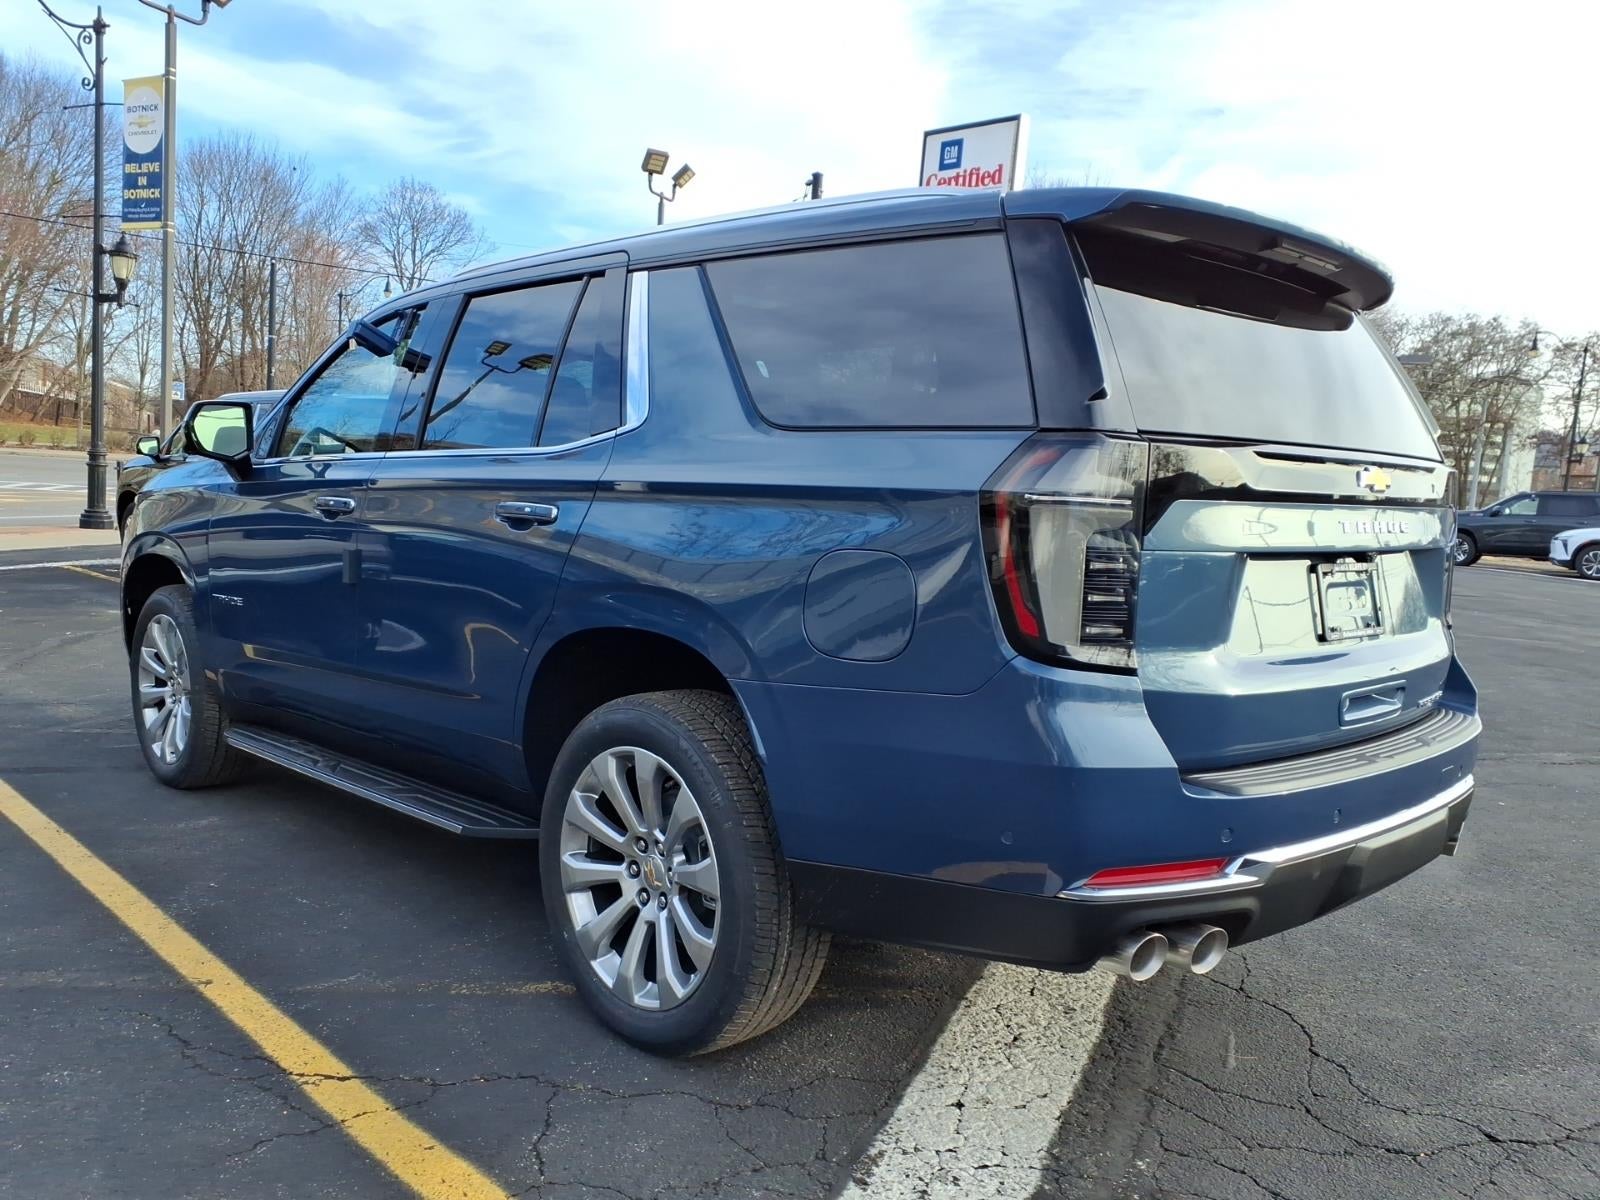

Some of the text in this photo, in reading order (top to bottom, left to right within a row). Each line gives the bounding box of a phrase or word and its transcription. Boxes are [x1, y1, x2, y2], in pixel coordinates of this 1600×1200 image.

[127, 104, 159, 113] BOTNICK
[944, 145, 958, 159] GM
[125, 162, 160, 173] BELIEVE
[138, 176, 147, 185] IN
[926, 164, 1003, 187] Certified
[124, 188, 160, 199] BOTNICK
[1338, 520, 1409, 534] TAHOE
